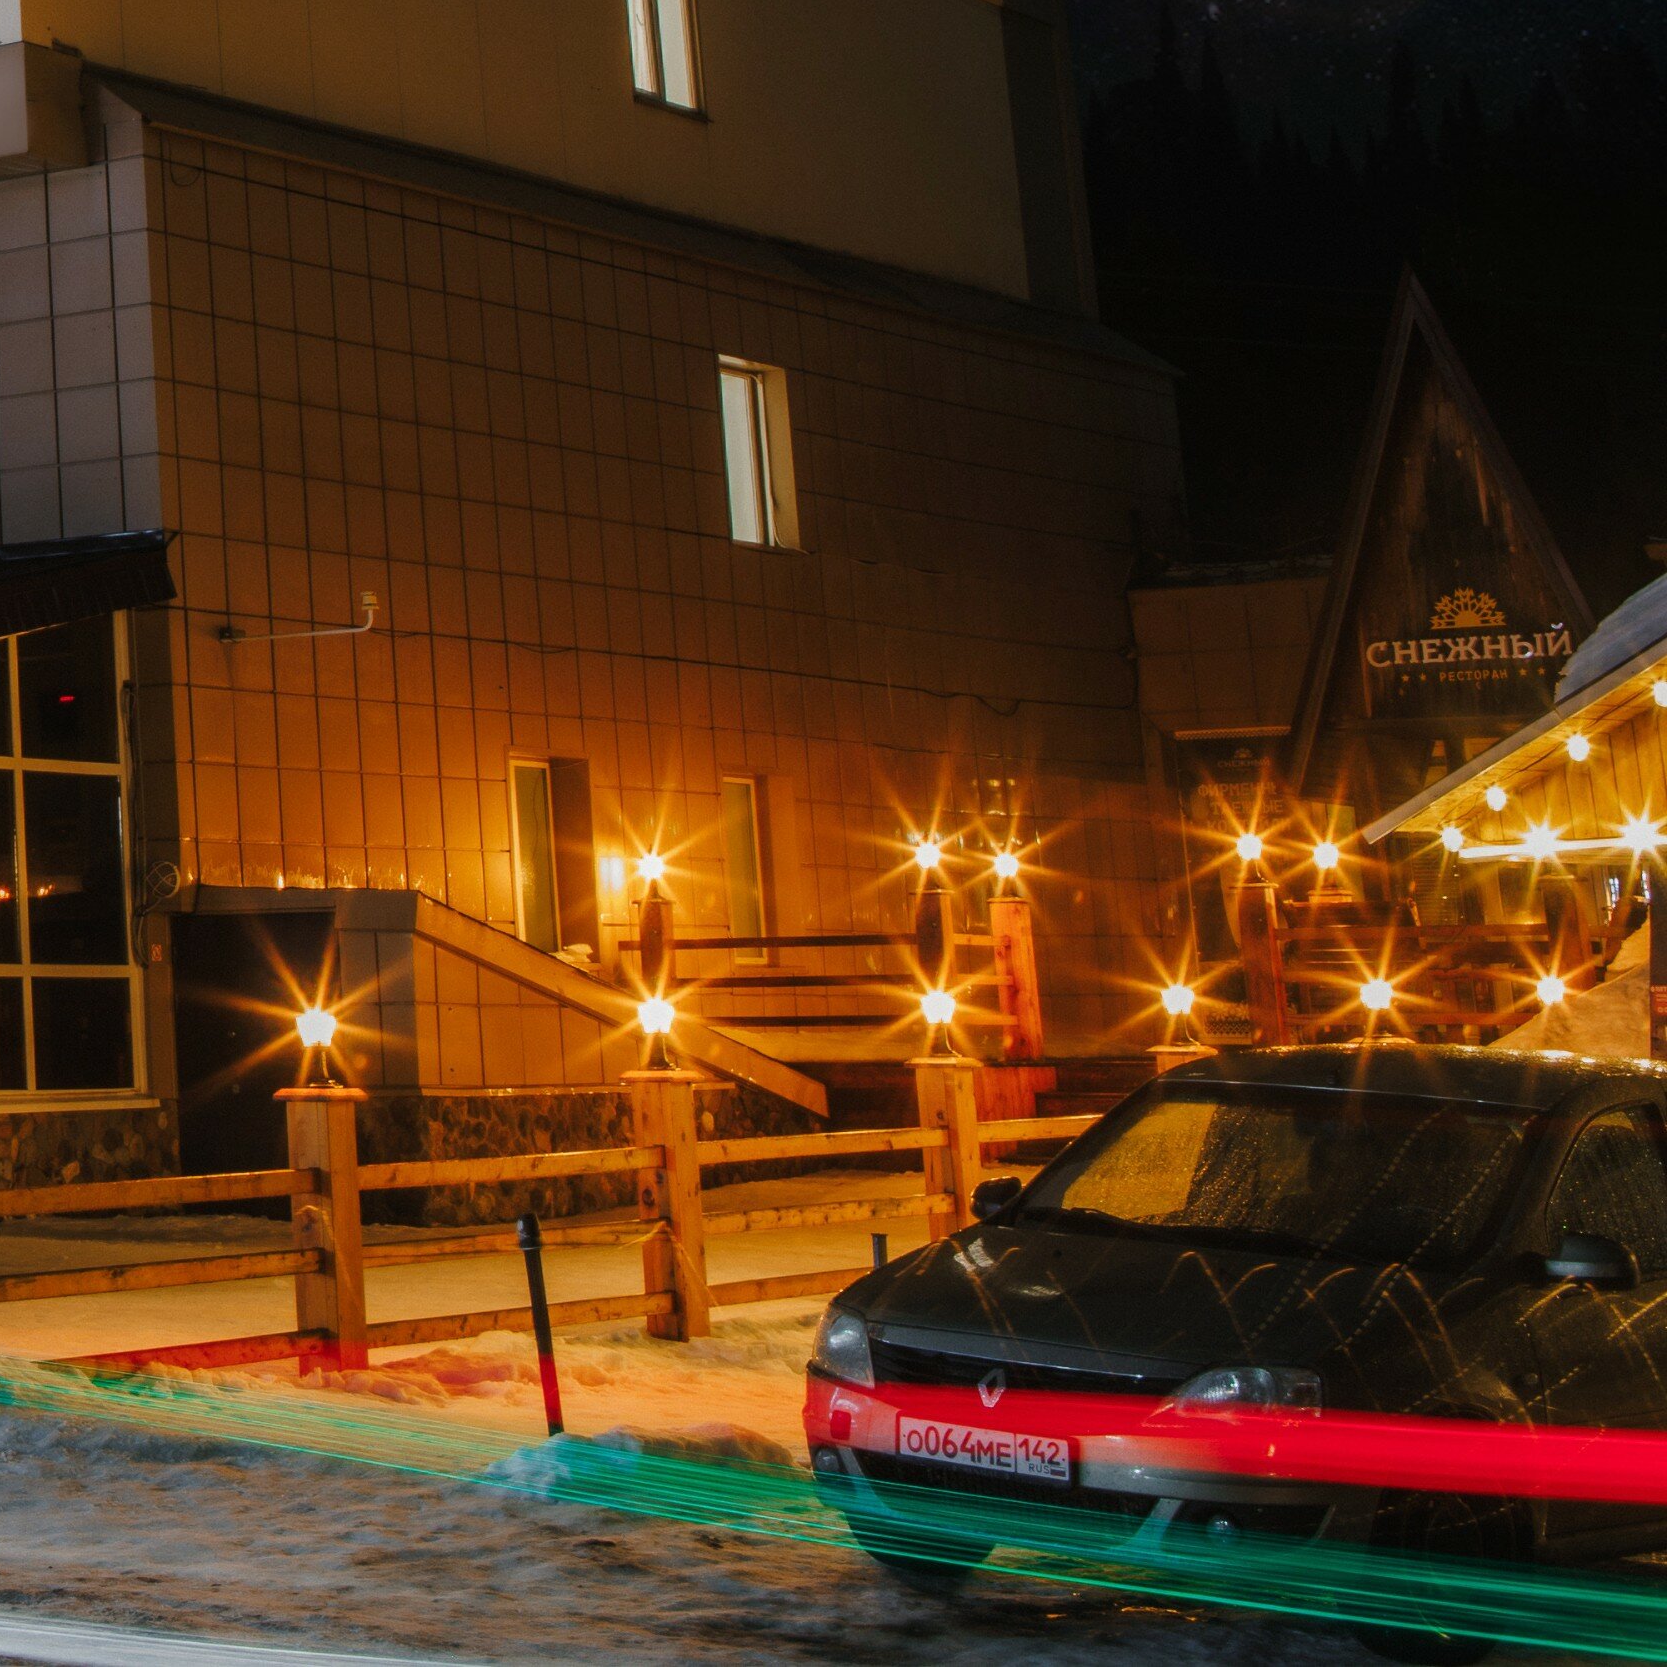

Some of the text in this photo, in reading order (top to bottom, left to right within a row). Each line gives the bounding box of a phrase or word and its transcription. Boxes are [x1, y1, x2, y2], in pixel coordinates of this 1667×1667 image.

[1365, 621, 1574, 669] СНЕЖНЫЙ
[1438, 669, 1509, 683] РЕСТОРАН
[1018, 1438, 1061, 1467] 142
[1028, 1463, 1051, 1474] RUS
